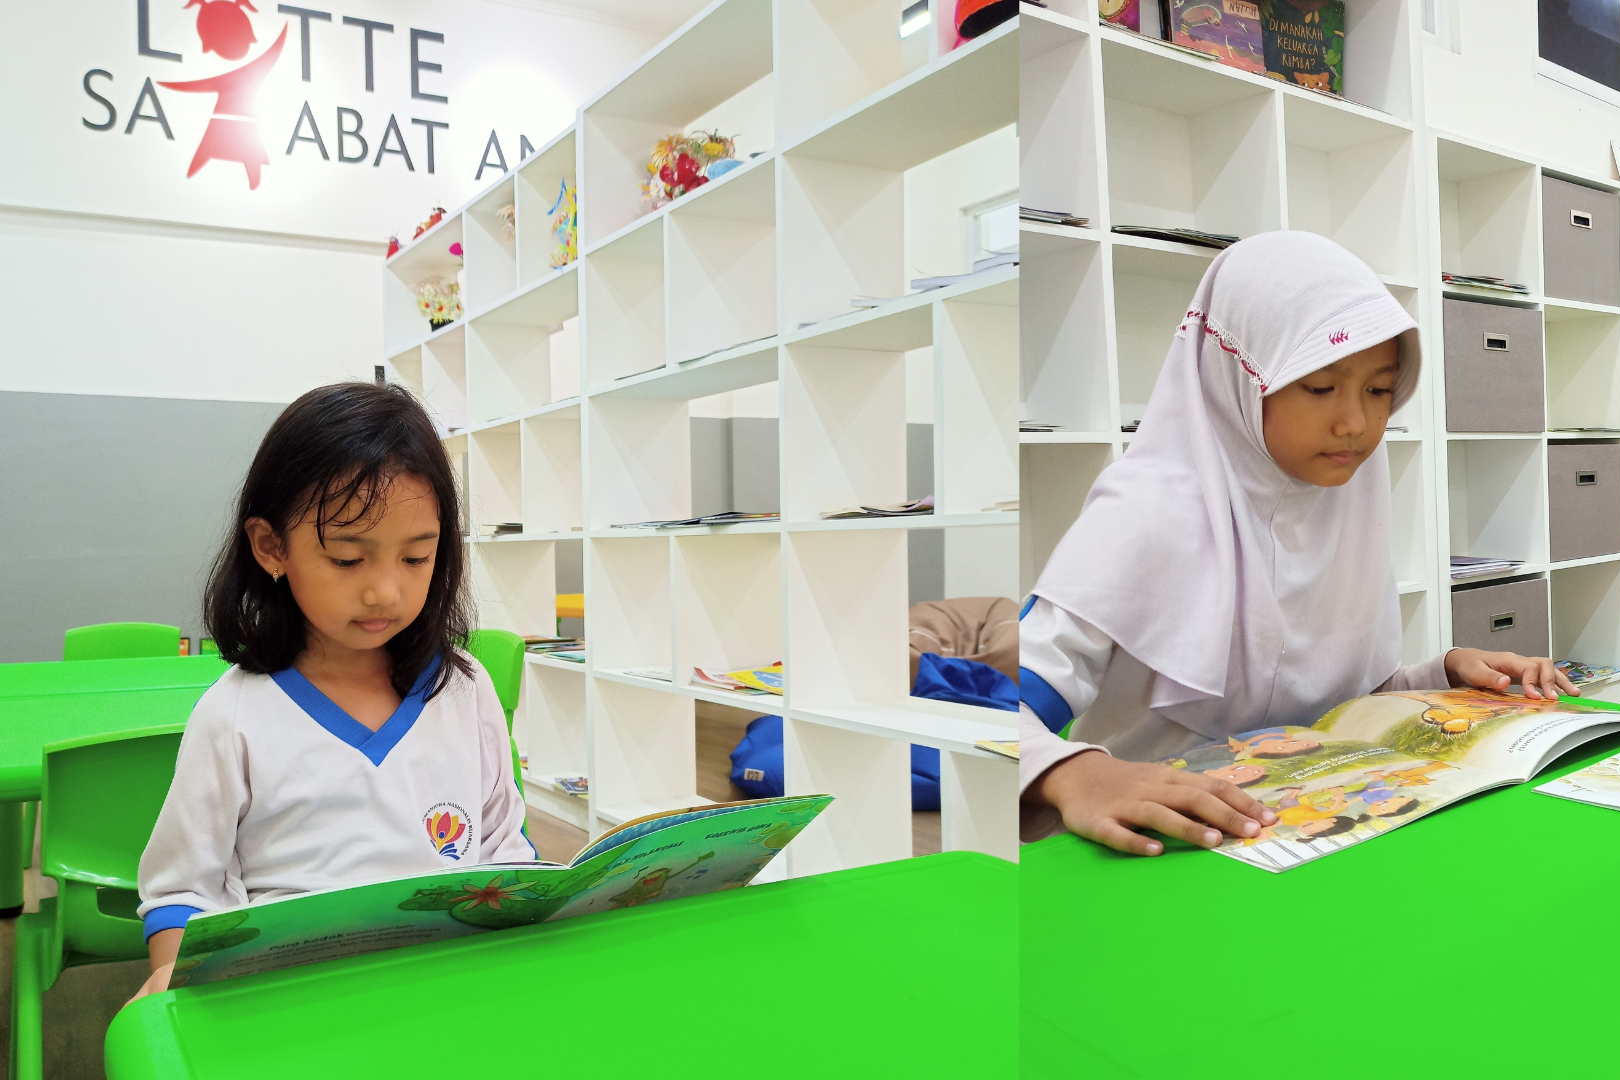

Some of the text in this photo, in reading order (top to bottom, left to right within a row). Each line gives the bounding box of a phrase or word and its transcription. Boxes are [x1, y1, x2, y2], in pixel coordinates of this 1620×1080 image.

[1269, 18, 1323, 41] DI MANAKAH
[1277, 34, 1319, 56] KELUARGA
[269, 941, 299, 950] Para
